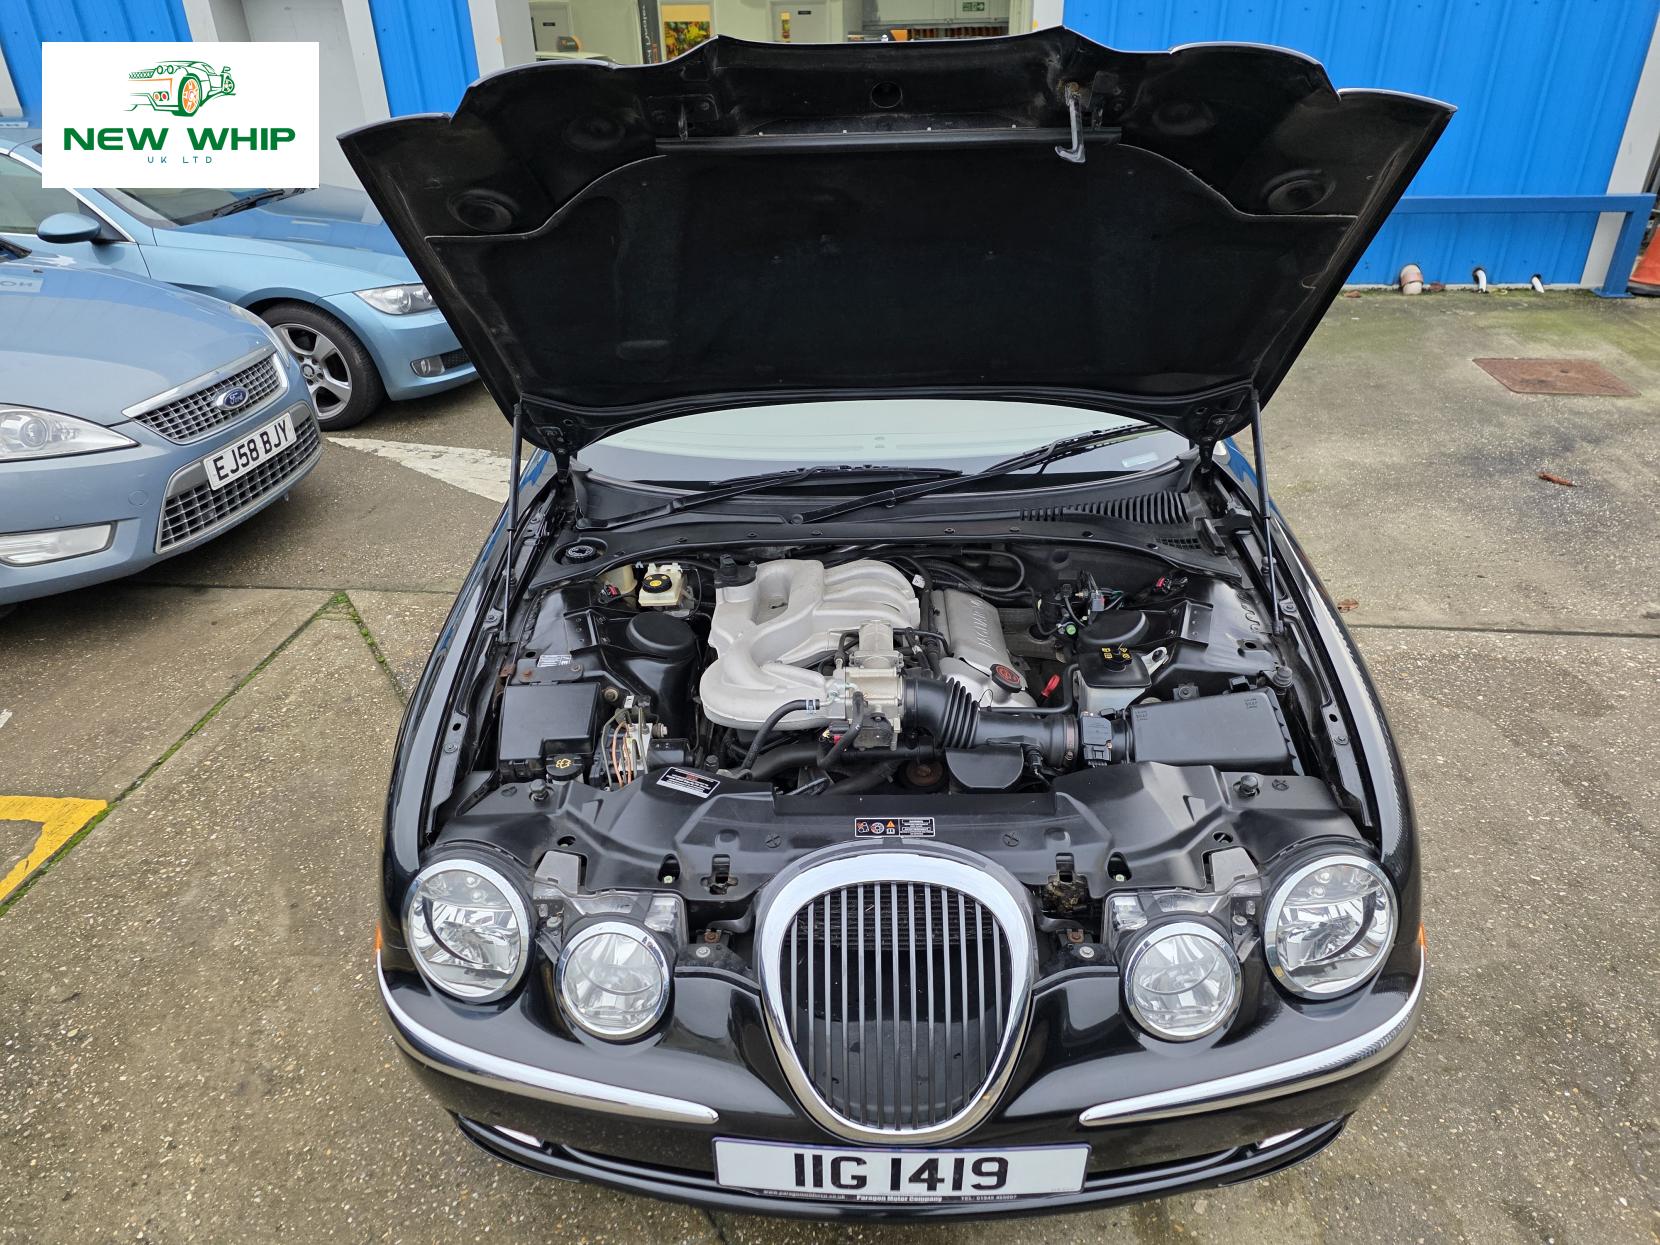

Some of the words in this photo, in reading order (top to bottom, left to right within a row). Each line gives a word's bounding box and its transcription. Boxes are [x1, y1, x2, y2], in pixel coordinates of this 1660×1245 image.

[212, 438, 260, 481] EJ58
[259, 419, 288, 455] BJY
[889, 1156, 1010, 1192] 1419
[856, 1194, 887, 1202] Paragon
